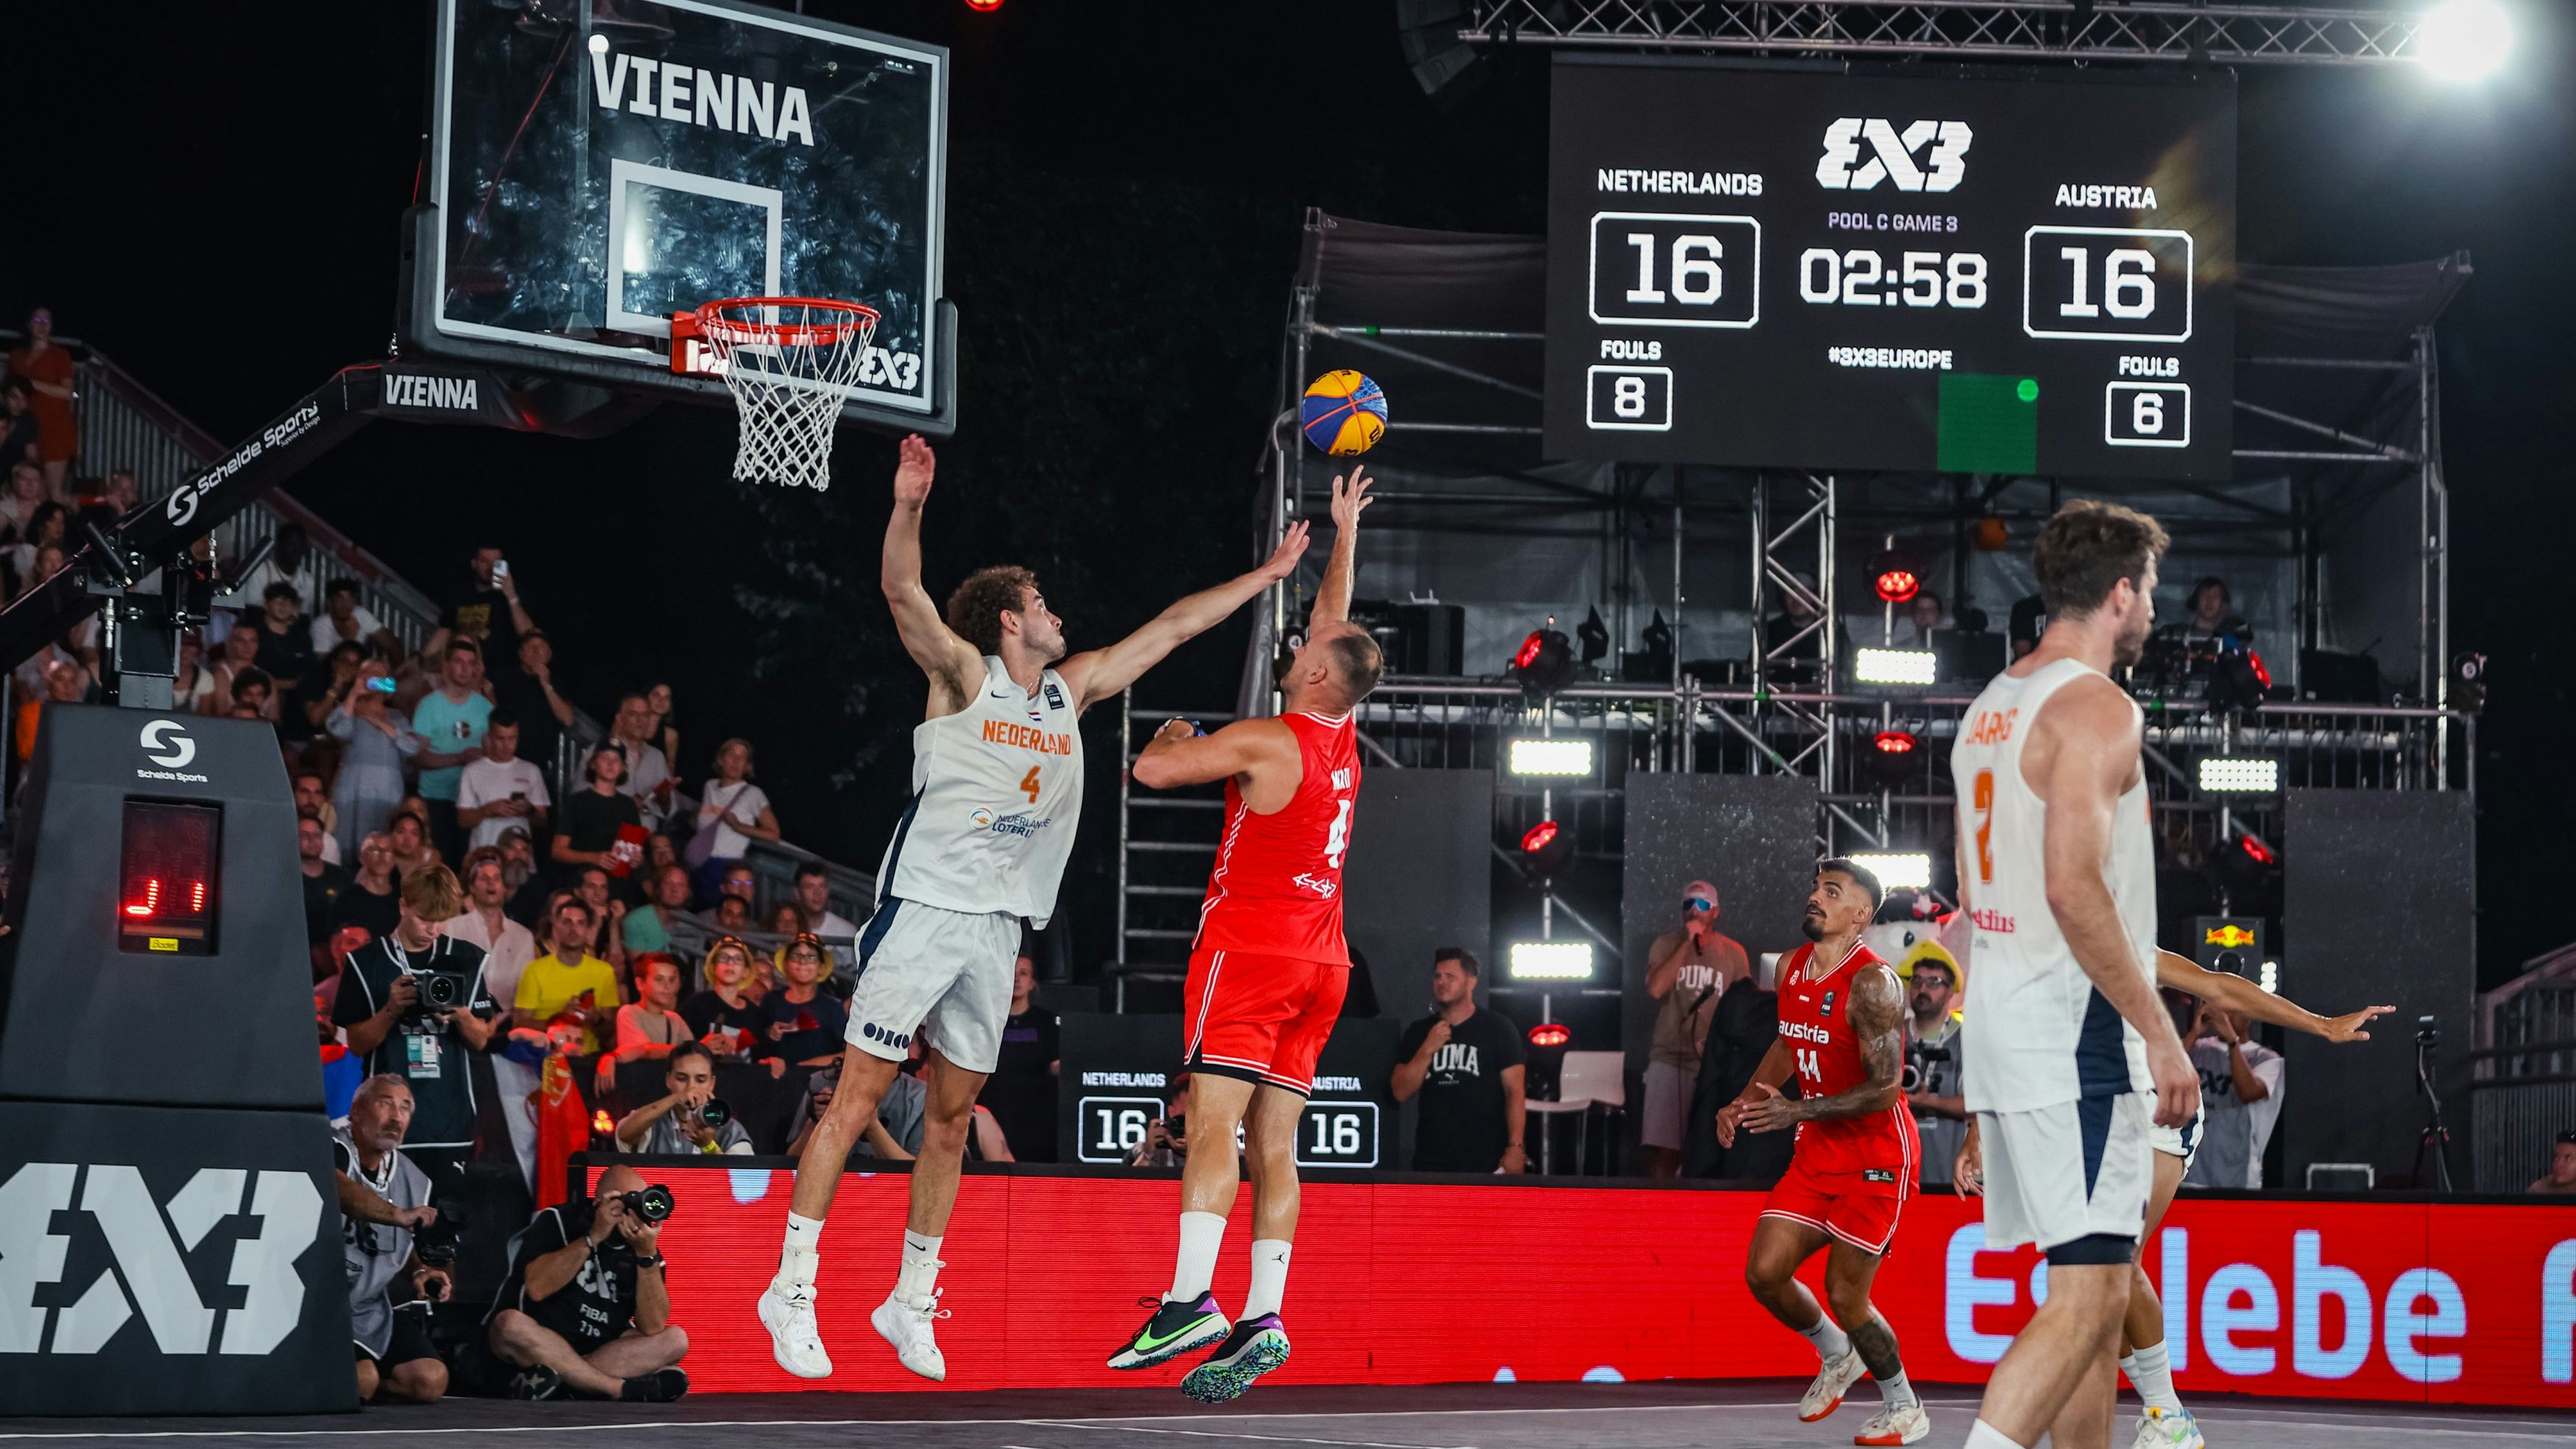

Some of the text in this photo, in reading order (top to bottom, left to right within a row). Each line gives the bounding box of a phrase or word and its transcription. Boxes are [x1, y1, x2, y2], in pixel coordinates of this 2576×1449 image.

[590, 52, 814, 146] VIENNA
[1598, 169, 1763, 196] NETHERLANDS
[2055, 183, 2158, 210] AUSTRIA
[1828, 211, 1958, 233] POOL C GAME 3
[1626, 233, 1723, 305] 16
[1800, 248, 1988, 309] 02:58
[2060, 247, 2156, 319] 16
[1600, 339, 1662, 361] FOULS
[1828, 346, 1953, 370] #3X3EUROPE
[2118, 355, 2180, 378] FOULS
[386, 374, 478, 410] VIENNA
[1614, 376, 1646, 419] 8
[2133, 392, 2164, 434] 6
[197, 442, 262, 496] Schelde
[263, 401, 319, 448] Sports
[982, 719, 1072, 756] NEDERLAND
[137, 769, 208, 783] Schelde Sports
[1019, 765, 1041, 804] 4
[1323, 799, 1351, 869] 4
[1973, 768, 1995, 883] 2
[1676, 965, 1723, 997] PUMA
[1778, 1020, 1830, 1044] austria
[1082, 1071, 1167, 1088] NETHERLANDS
[1426, 1043, 1480, 1080] UMA
[1797, 1048, 1822, 1083] 44
[1310, 1076, 1362, 1091] AUSTRIA
[1096, 1109, 1147, 1149] 16
[1310, 1113, 1360, 1154] 16
[1945, 1222, 2049, 1364] E
[2161, 1227, 2468, 1384] lebe
